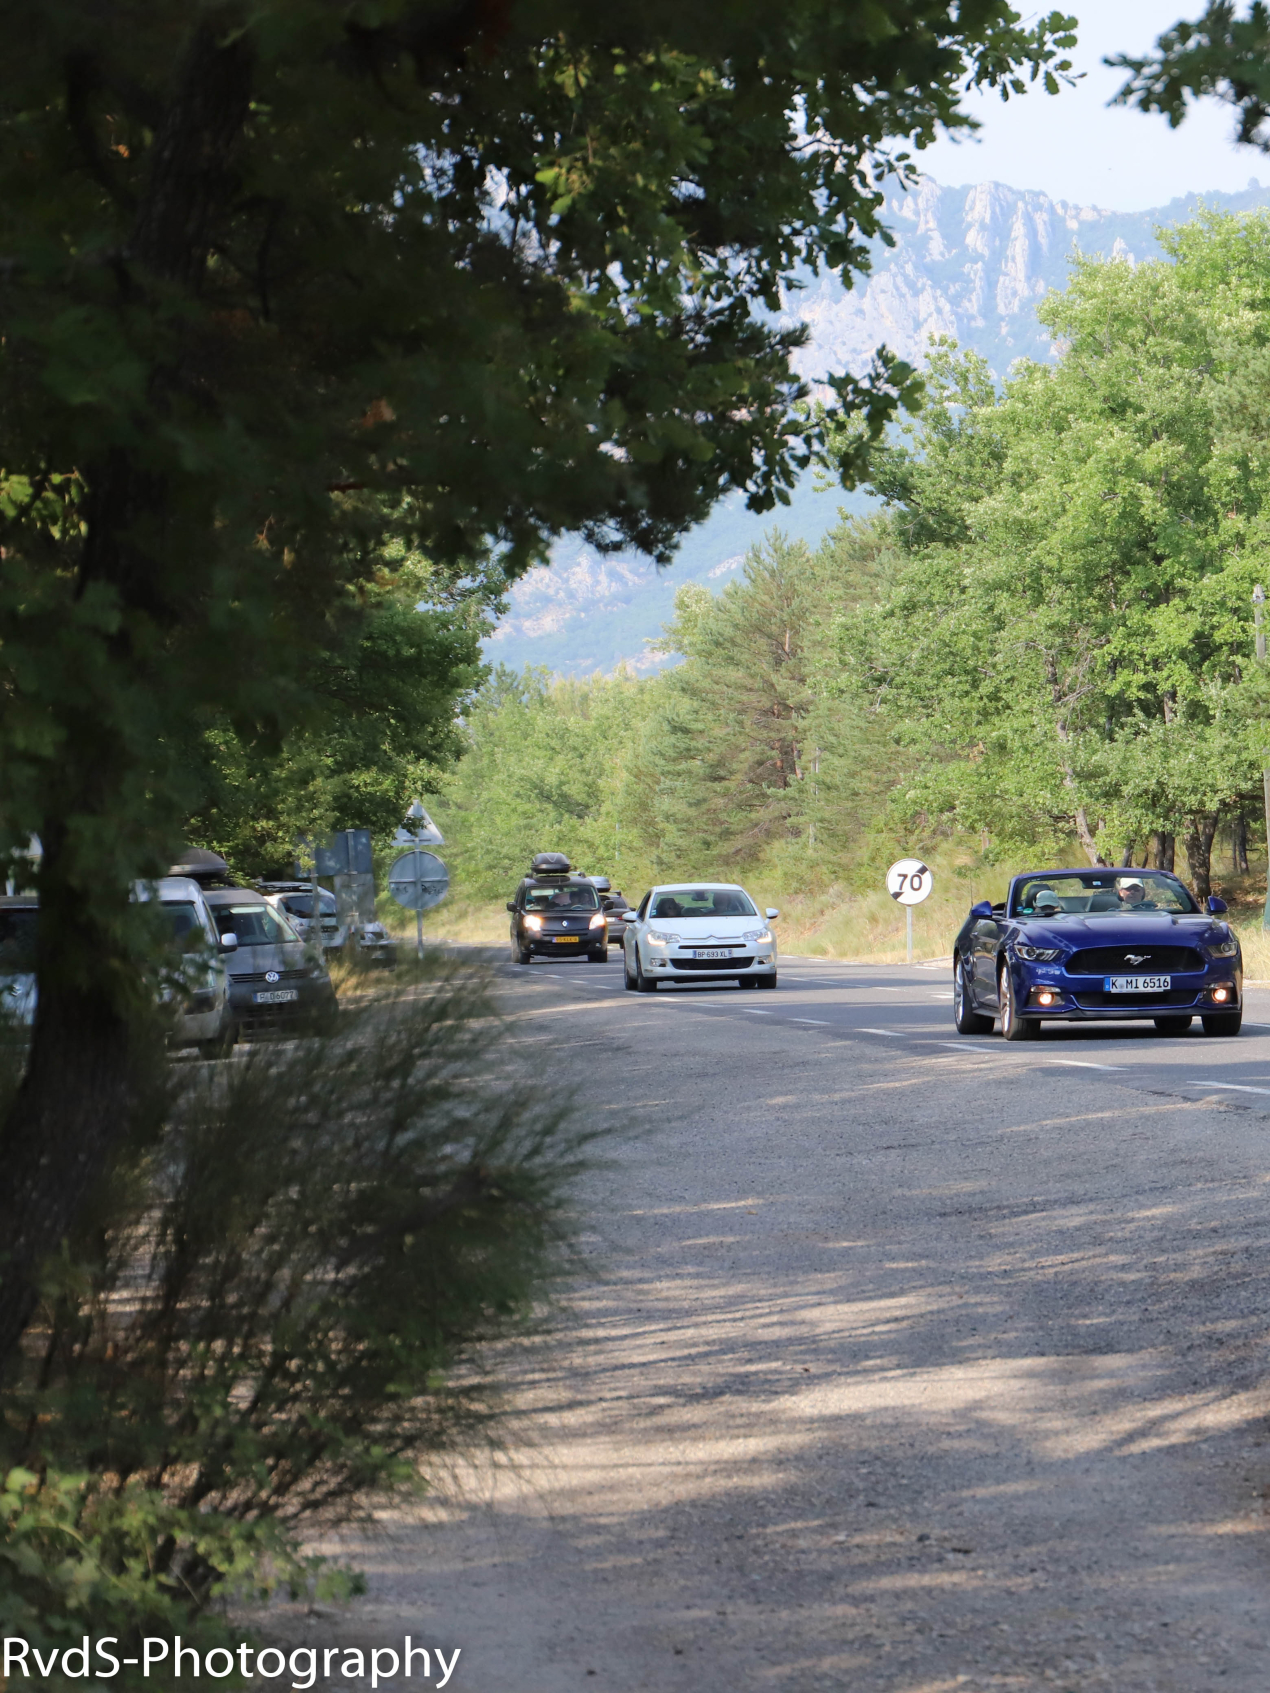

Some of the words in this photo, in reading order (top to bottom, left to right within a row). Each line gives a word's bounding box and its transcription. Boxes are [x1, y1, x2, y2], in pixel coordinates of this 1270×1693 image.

[896, 873, 923, 892] 70
[1111, 979, 1118, 989] K
[1126, 979, 1139, 989] MI
[1142, 978, 1169, 989] 6516
